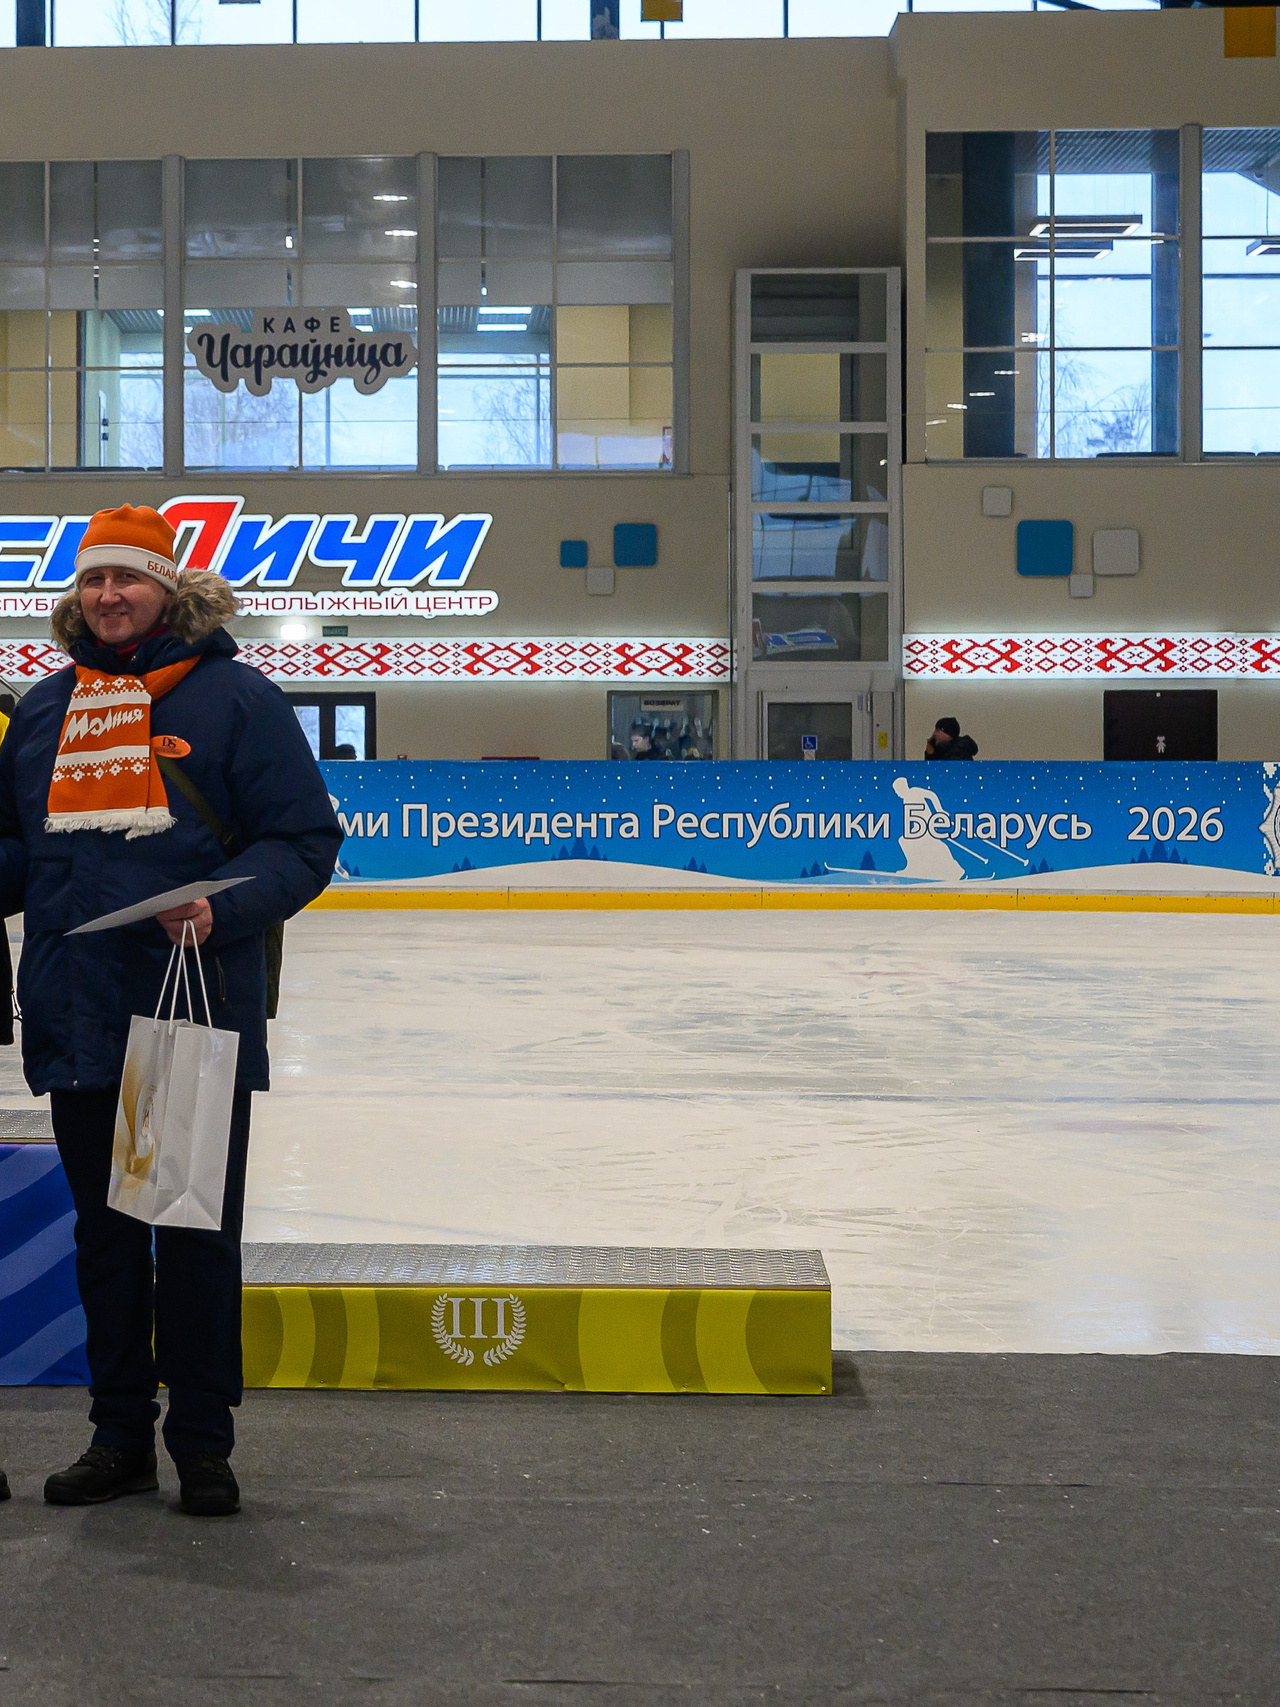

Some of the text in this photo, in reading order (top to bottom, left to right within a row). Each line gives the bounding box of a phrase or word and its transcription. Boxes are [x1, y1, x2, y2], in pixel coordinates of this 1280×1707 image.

[263, 315, 341, 334] КАФЕ
[197, 332, 408, 386] Чараўніца
[415, 596, 494, 614] ЦЕНТР
[57, 708, 145, 754] Молния
[402, 803, 640, 847] Президента
[652, 803, 890, 848] Республики
[903, 804, 1093, 848] Беларусь
[1127, 805, 1225, 842] 2026
[446, 1297, 510, 1339] III
